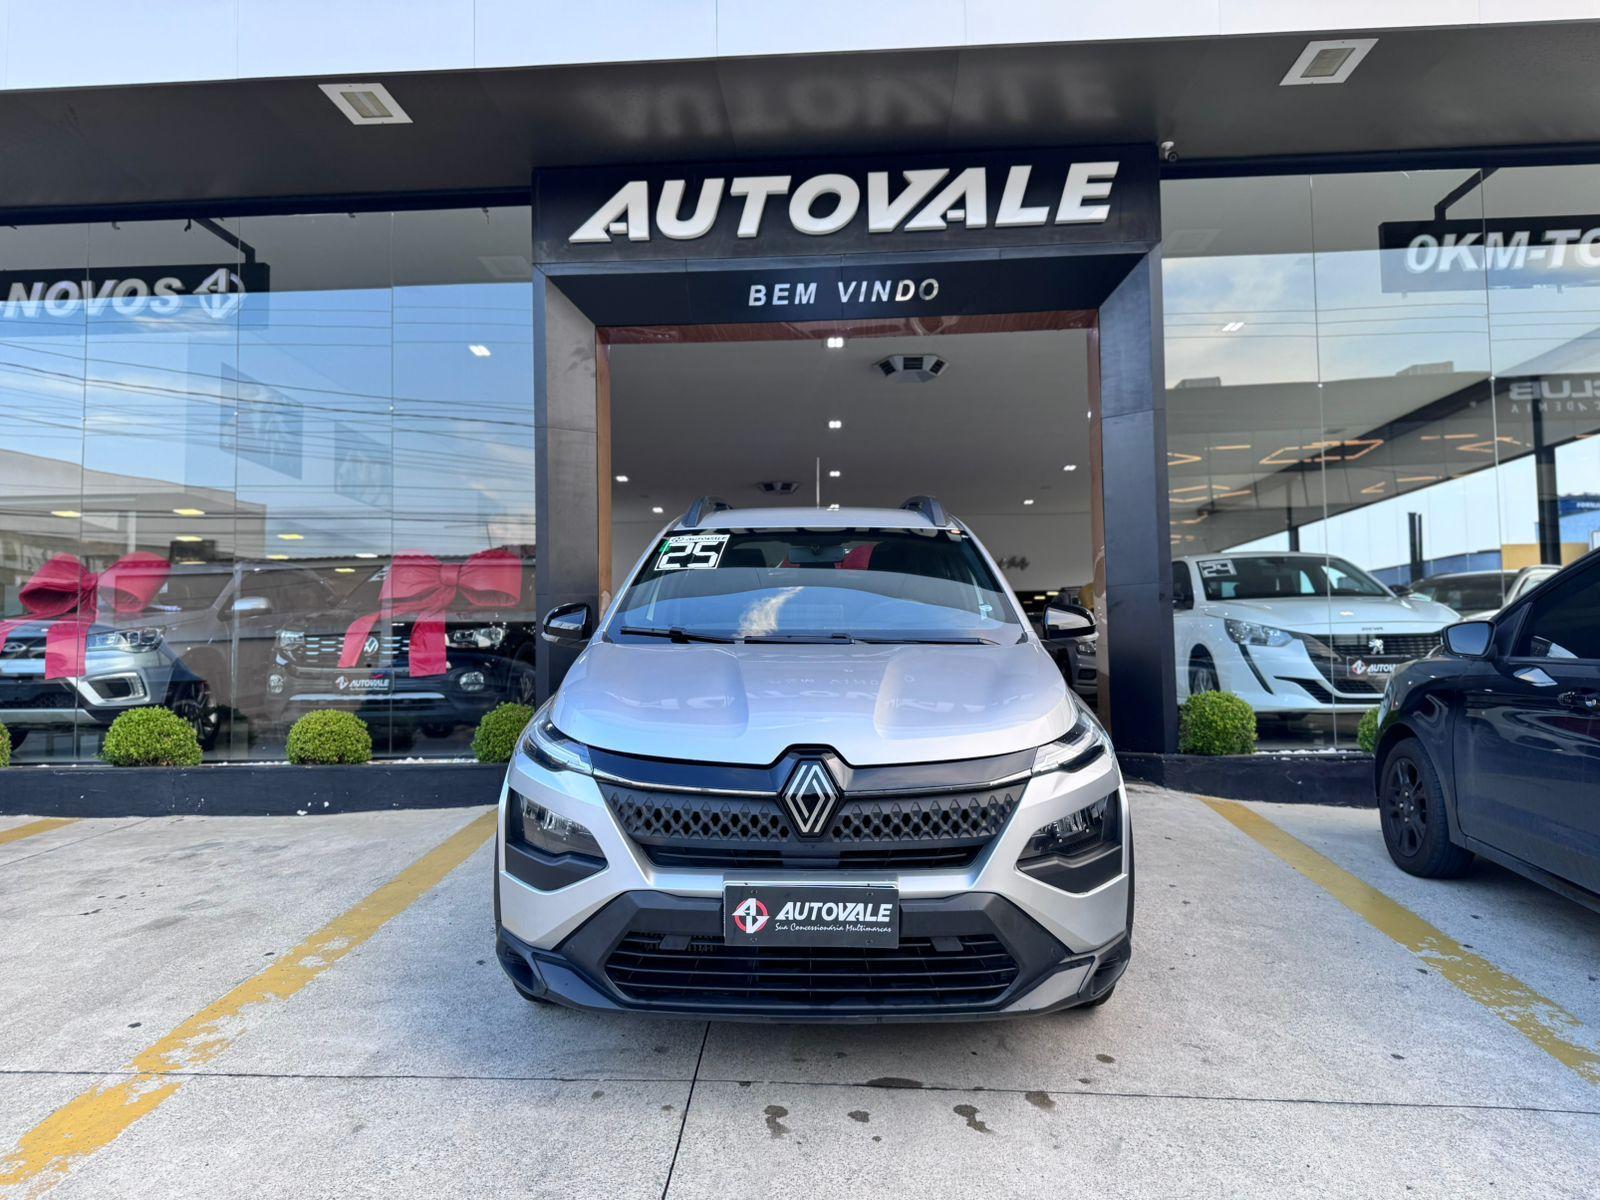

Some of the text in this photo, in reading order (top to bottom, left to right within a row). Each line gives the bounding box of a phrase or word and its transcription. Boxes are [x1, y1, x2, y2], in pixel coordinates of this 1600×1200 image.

[568, 161, 1120, 243] AUTOVALE
[3, 276, 186, 318] NOVOS
[748, 278, 939, 306] BEM VINDO
[658, 541, 719, 569] 25
[775, 901, 893, 922] AUTOVALE
[775, 922, 789, 932] Sua
[845, 923, 893, 933] Multimarcas
